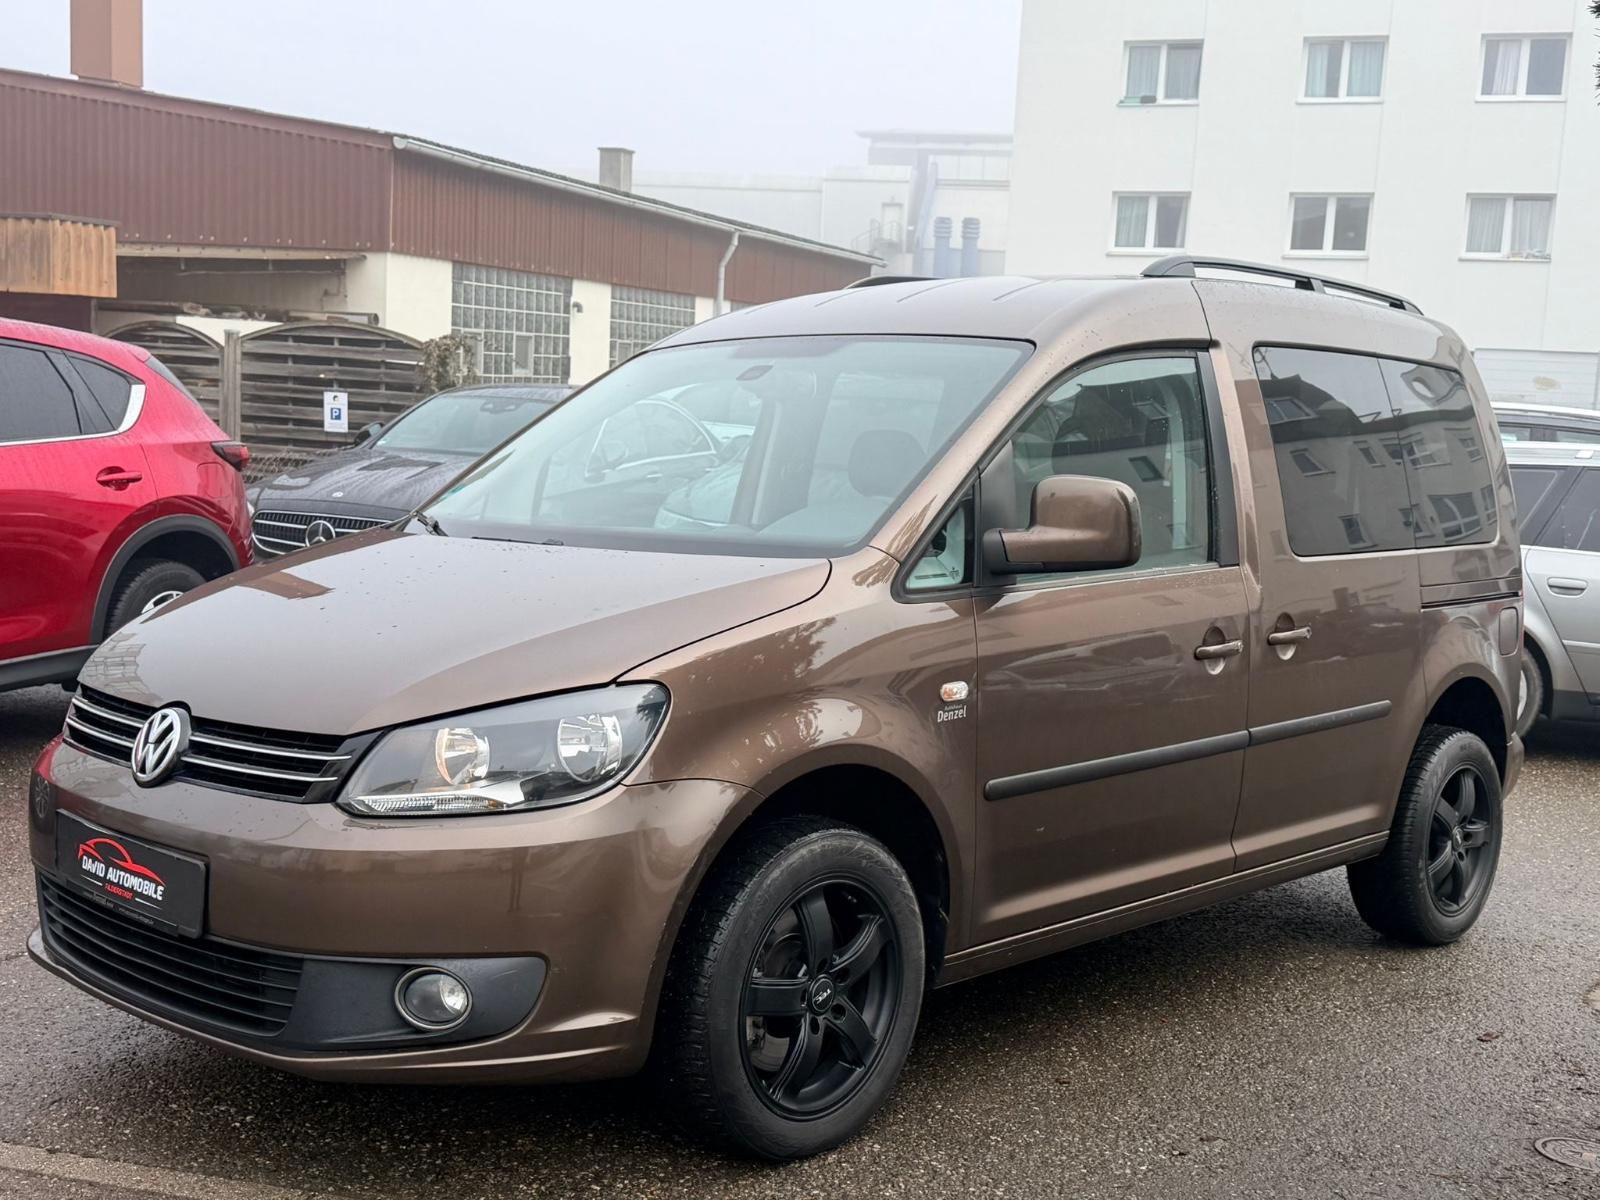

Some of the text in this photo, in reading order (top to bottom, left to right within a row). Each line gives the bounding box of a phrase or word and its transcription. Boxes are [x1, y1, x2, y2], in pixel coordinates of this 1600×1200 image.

[937, 704, 967, 723] Denzel
[82, 855, 106, 878] DAVID
[106, 866, 165, 901] AUTOMOBILE
